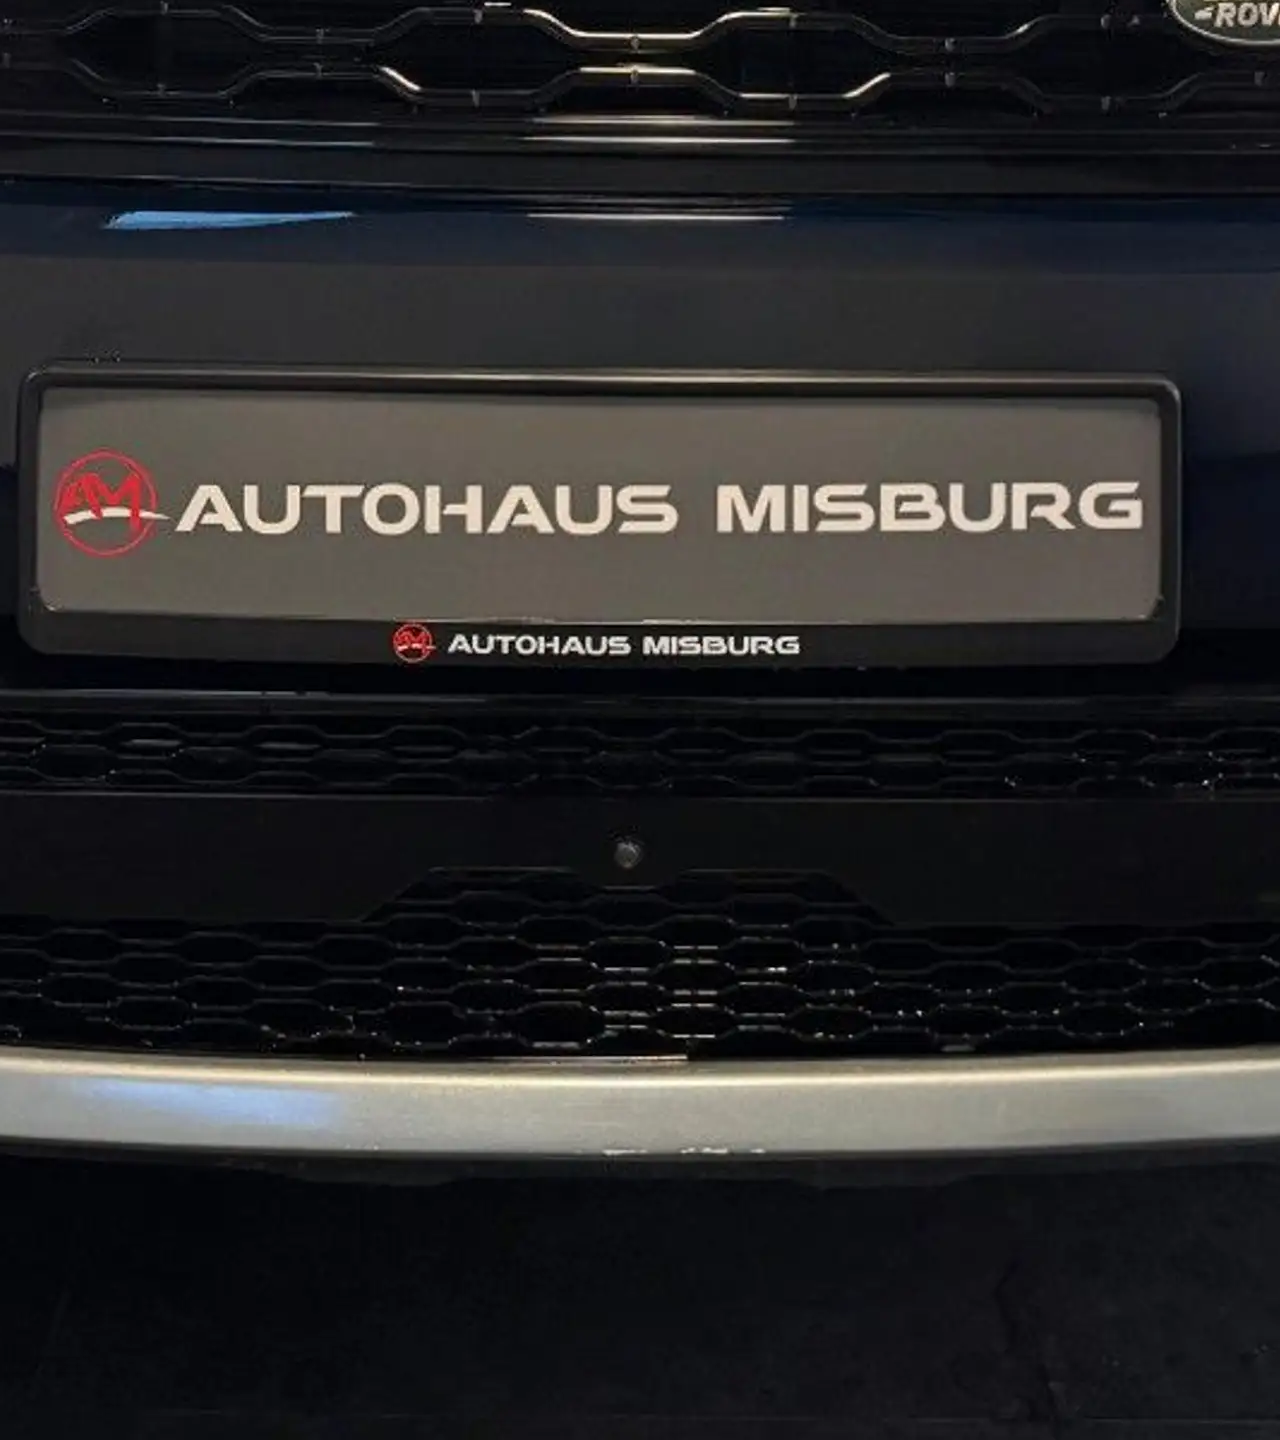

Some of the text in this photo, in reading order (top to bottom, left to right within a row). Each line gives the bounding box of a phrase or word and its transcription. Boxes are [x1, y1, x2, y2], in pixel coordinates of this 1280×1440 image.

[175, 483, 678, 536] AUTOHAUS
[715, 480, 1144, 533] MISBURG
[447, 634, 631, 656] AUTOHAUS
[641, 634, 800, 655] MISBURG
